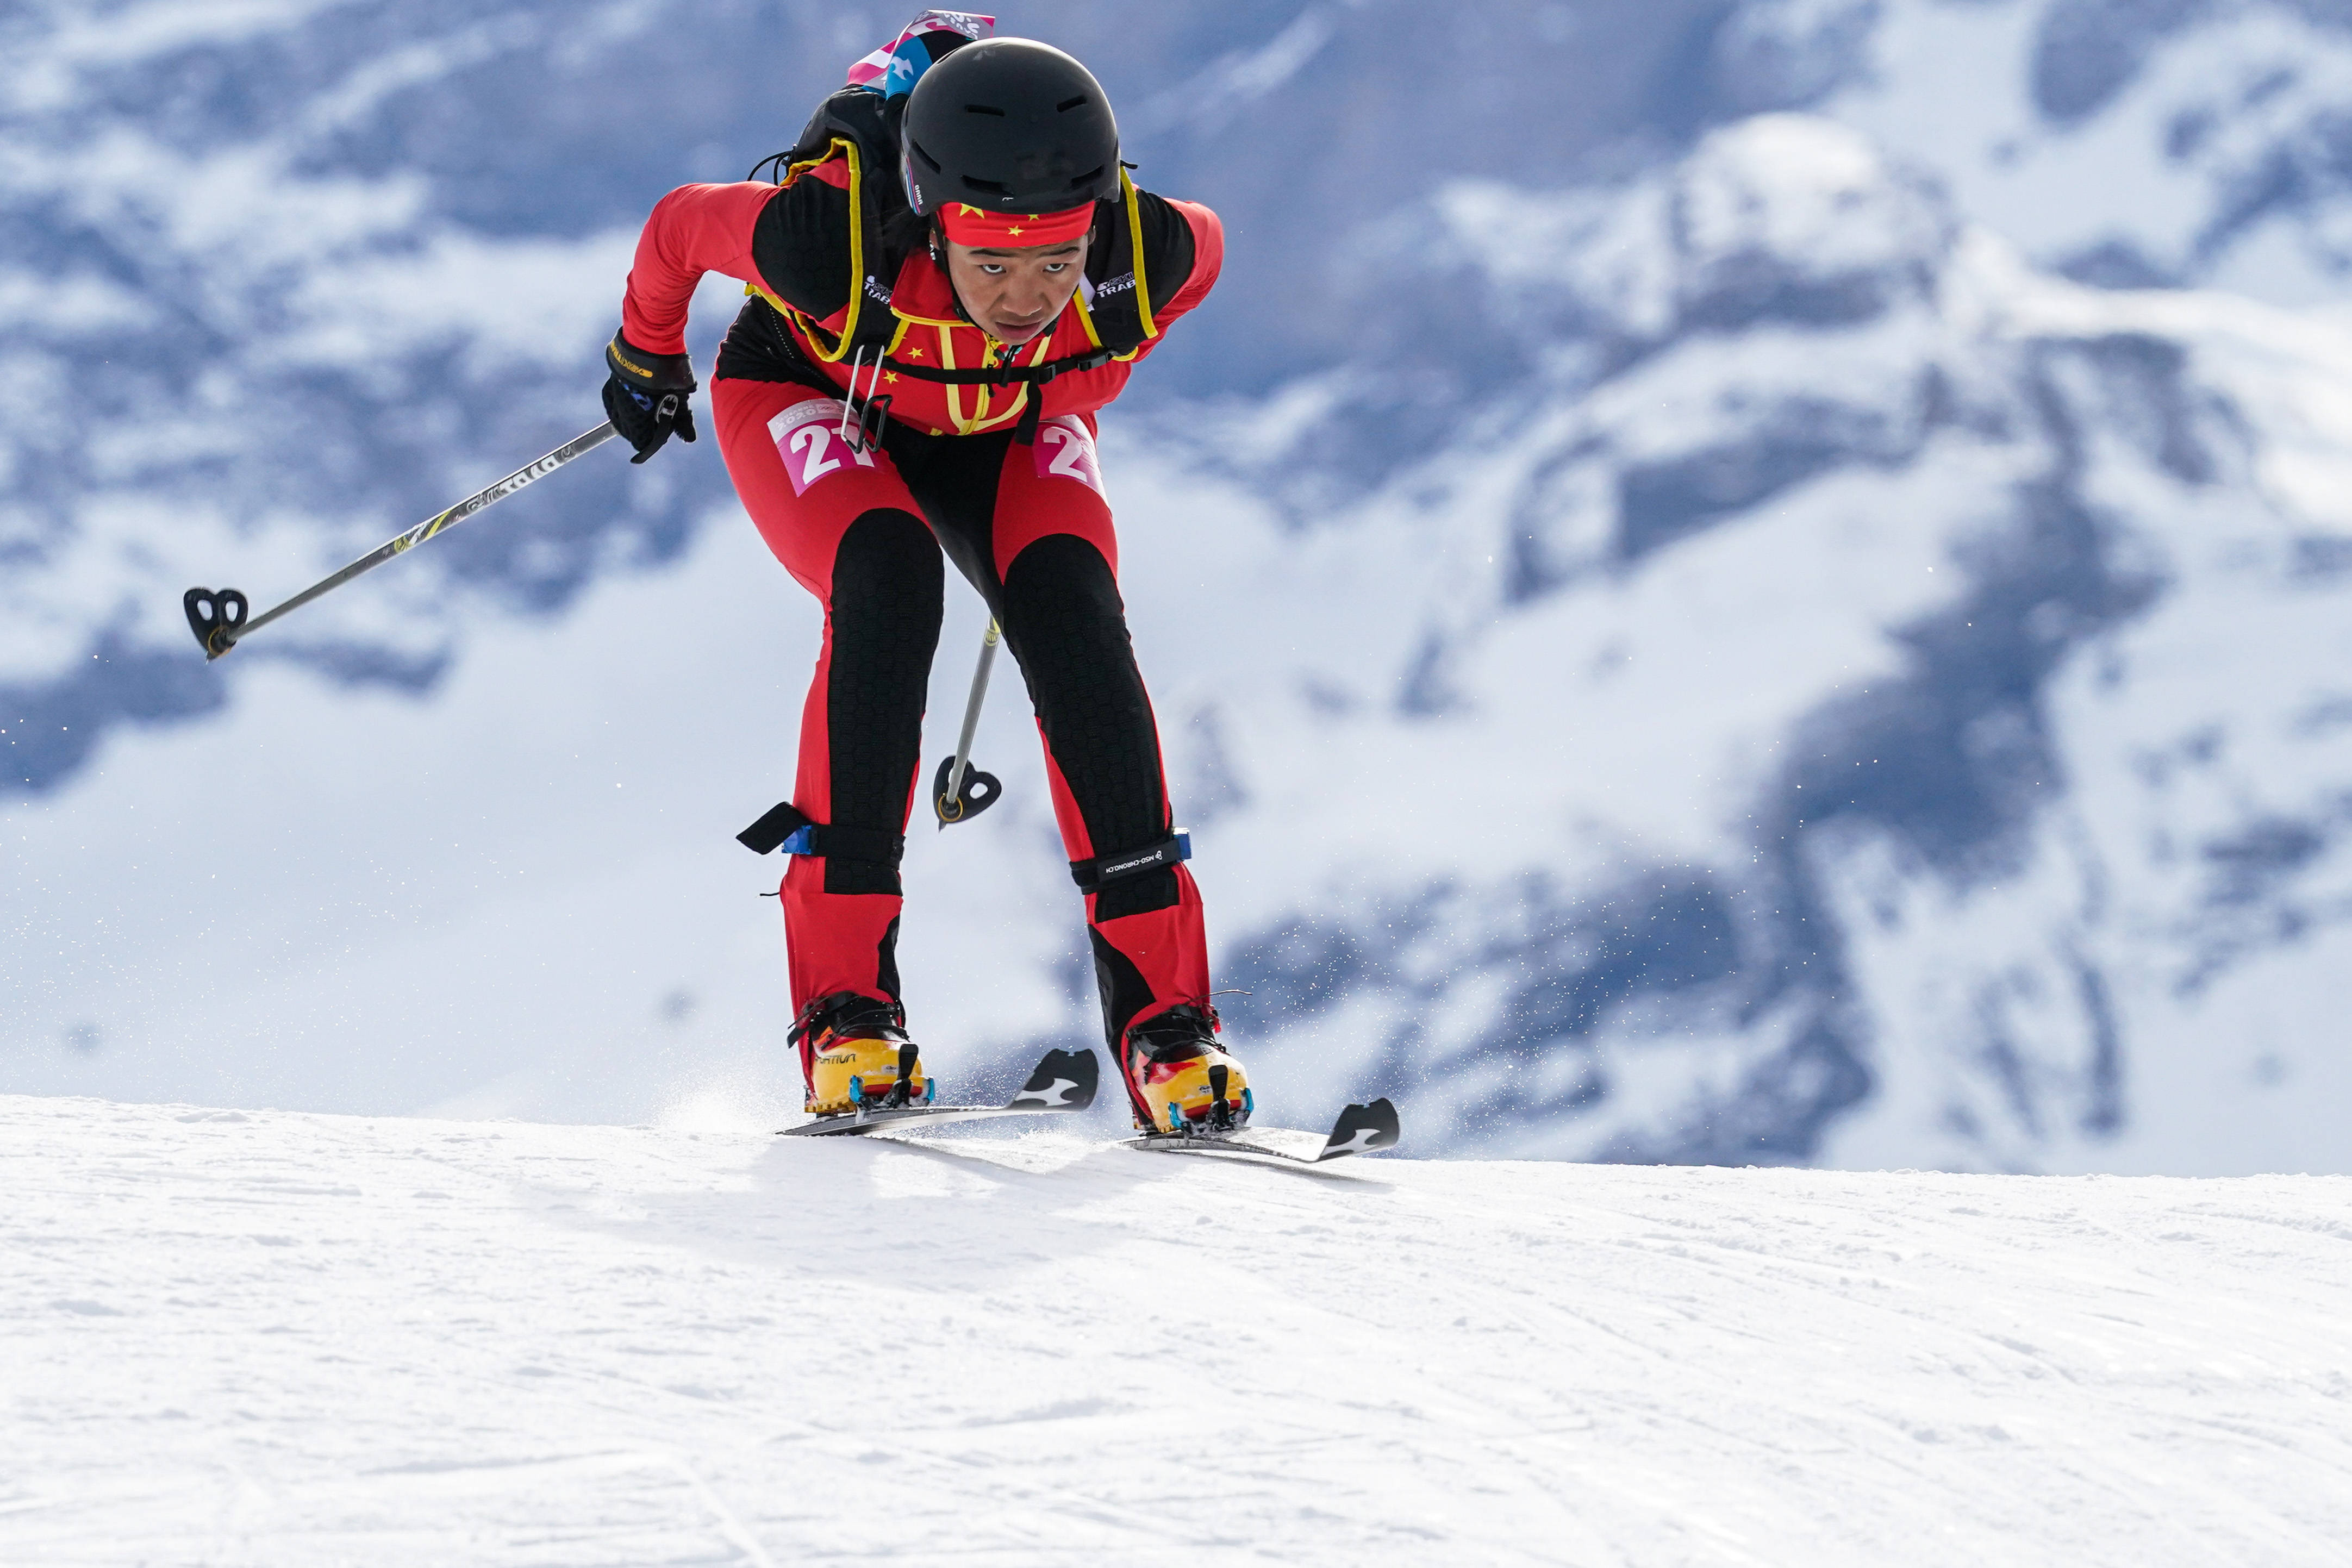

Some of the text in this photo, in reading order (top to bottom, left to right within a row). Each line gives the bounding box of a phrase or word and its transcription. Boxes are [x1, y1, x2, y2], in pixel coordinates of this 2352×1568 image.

[864, 282, 890, 304] TRAB
[1097, 279, 1136, 298] TRAB
[1042, 426, 1095, 483] 2
